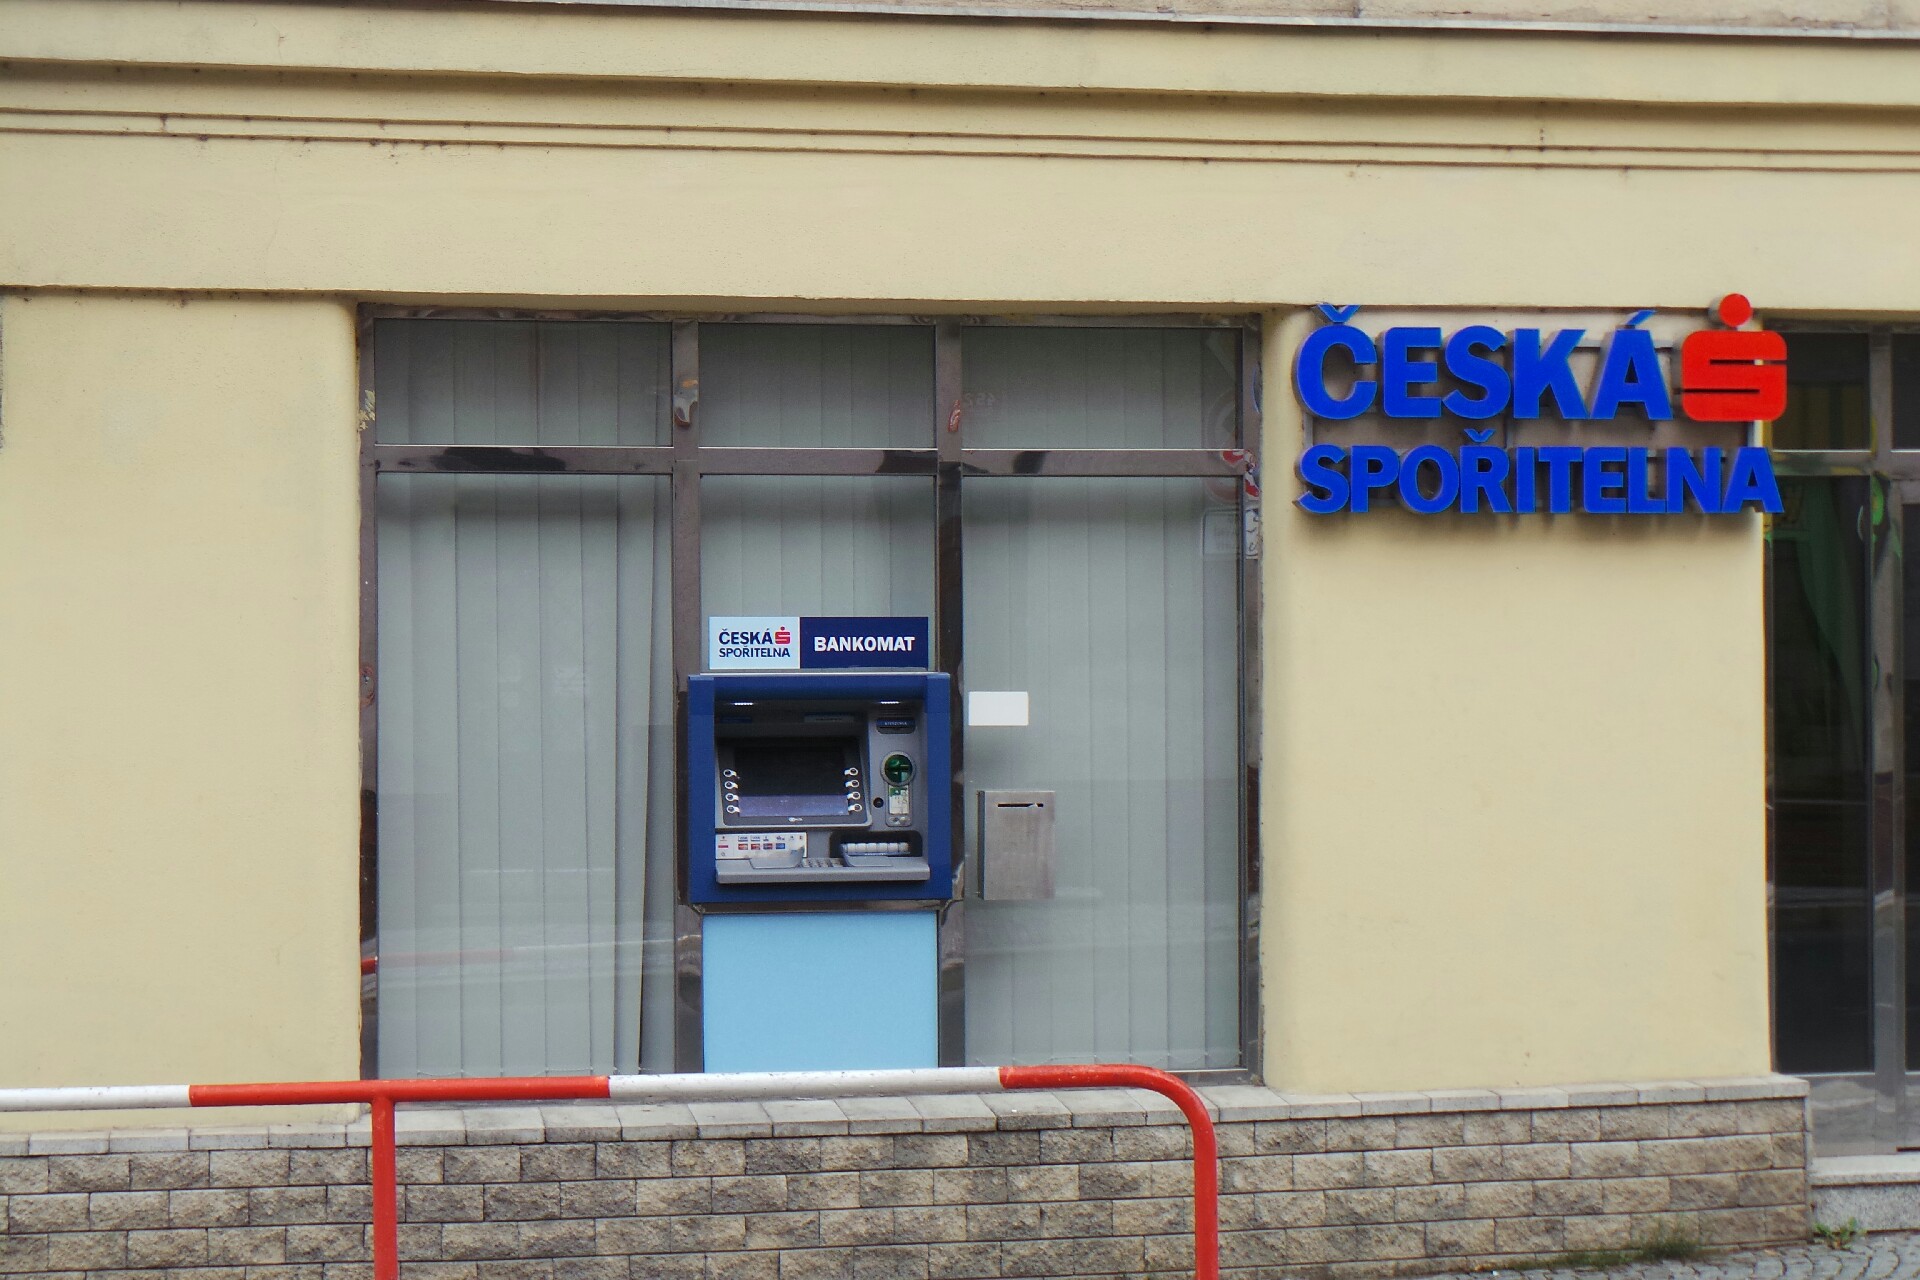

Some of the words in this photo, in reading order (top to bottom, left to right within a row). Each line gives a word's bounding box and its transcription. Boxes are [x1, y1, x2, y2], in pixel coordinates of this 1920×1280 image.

[1296, 302, 1673, 420] ČESKÁ
[1297, 428, 1784, 513] SPOŘITELNA
[718, 628, 773, 645] ČESKÁ
[814, 636, 915, 652] BANKOMAT
[718, 645, 791, 658] SPOŘITELNA
